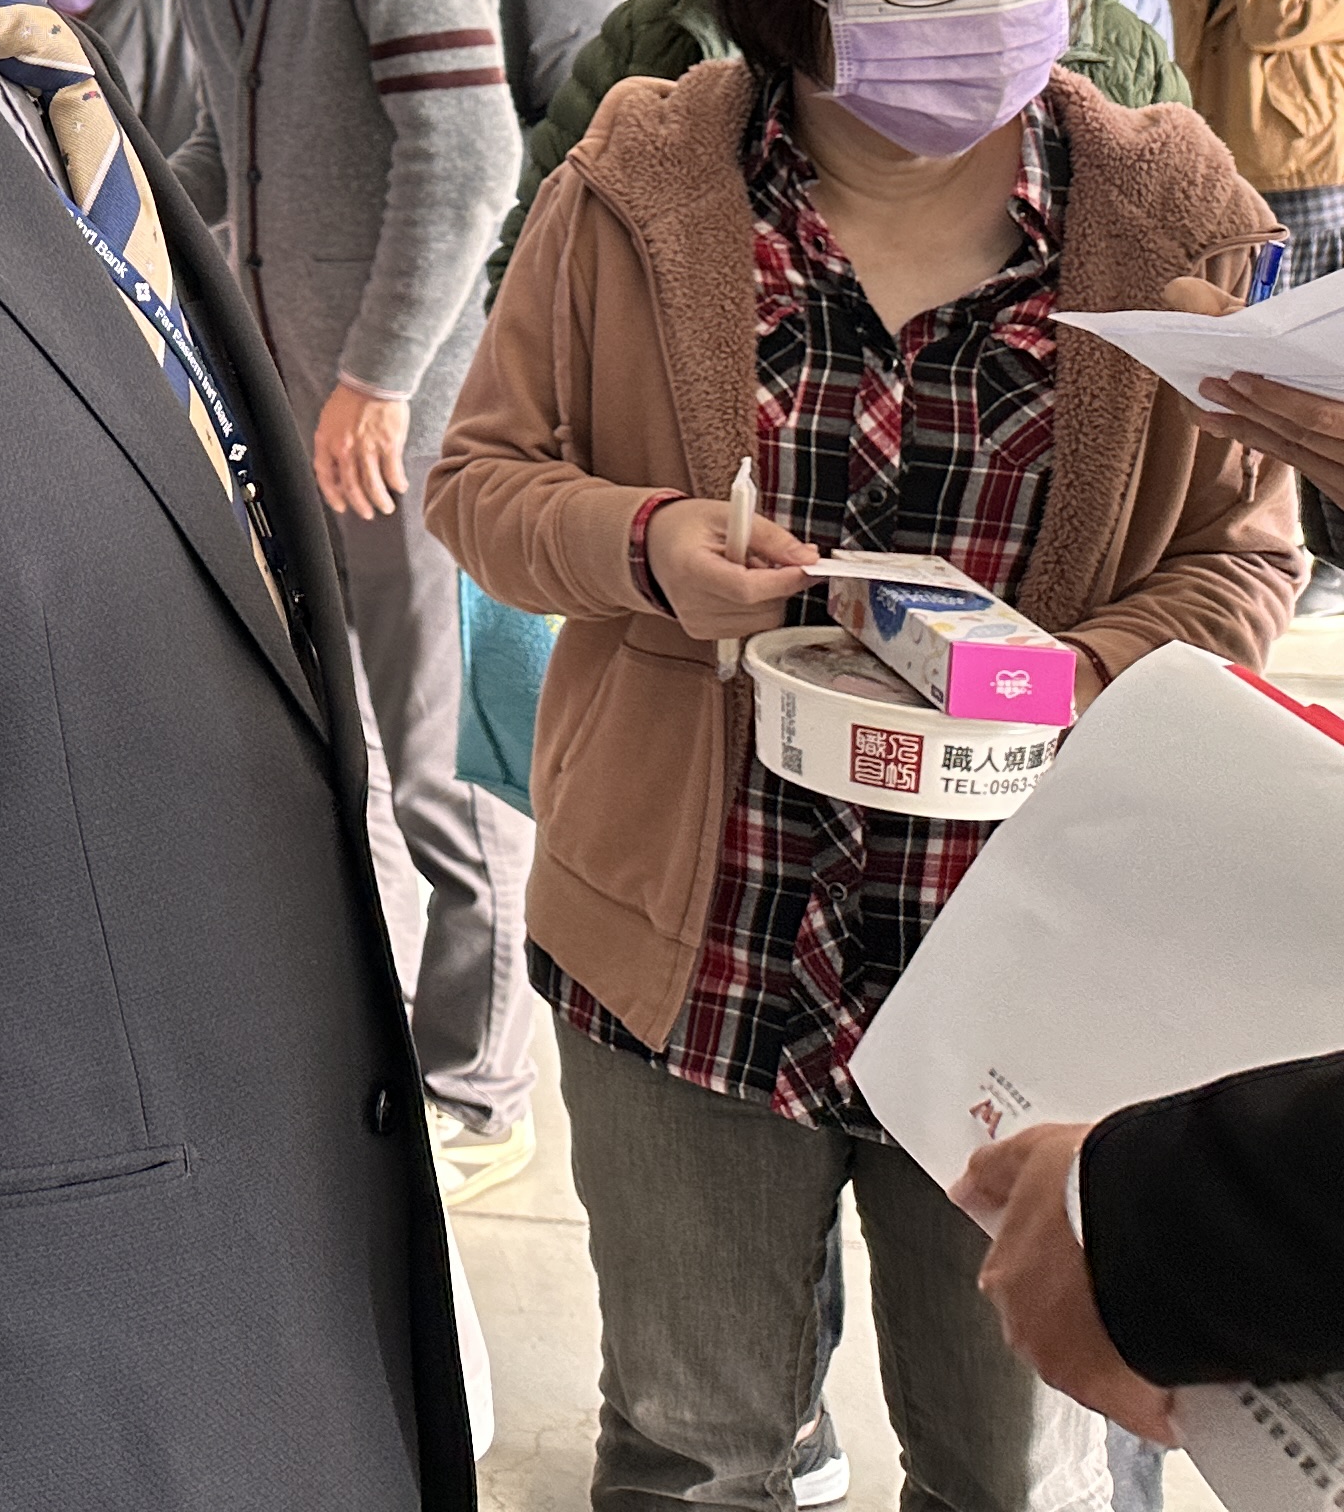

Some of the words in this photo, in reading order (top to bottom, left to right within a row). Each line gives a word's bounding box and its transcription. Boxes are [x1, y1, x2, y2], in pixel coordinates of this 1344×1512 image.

[94, 239, 128, 279] Bank
[155, 305, 175, 332] Far
[172, 327, 204, 381] Eastern
[213, 399, 235, 438] Bank
[940, 770, 1046, 796] TEL:0963-3
